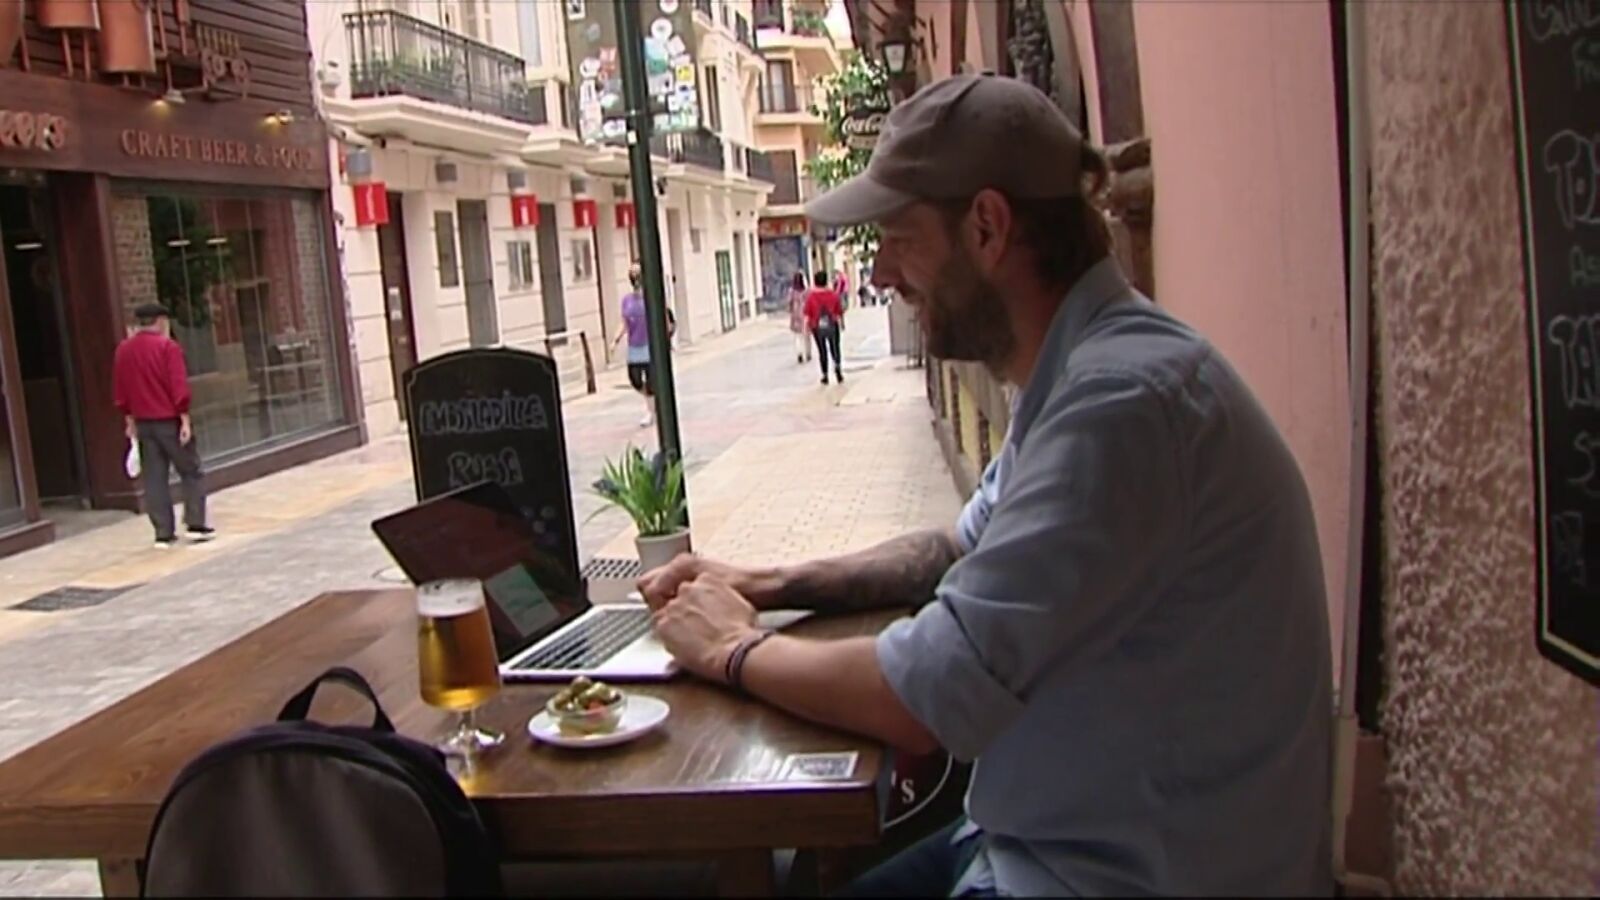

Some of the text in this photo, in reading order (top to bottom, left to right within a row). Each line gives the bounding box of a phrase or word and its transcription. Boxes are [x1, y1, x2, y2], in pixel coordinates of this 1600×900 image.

[122, 129, 313, 170] CRAFT BEER & FOOD
